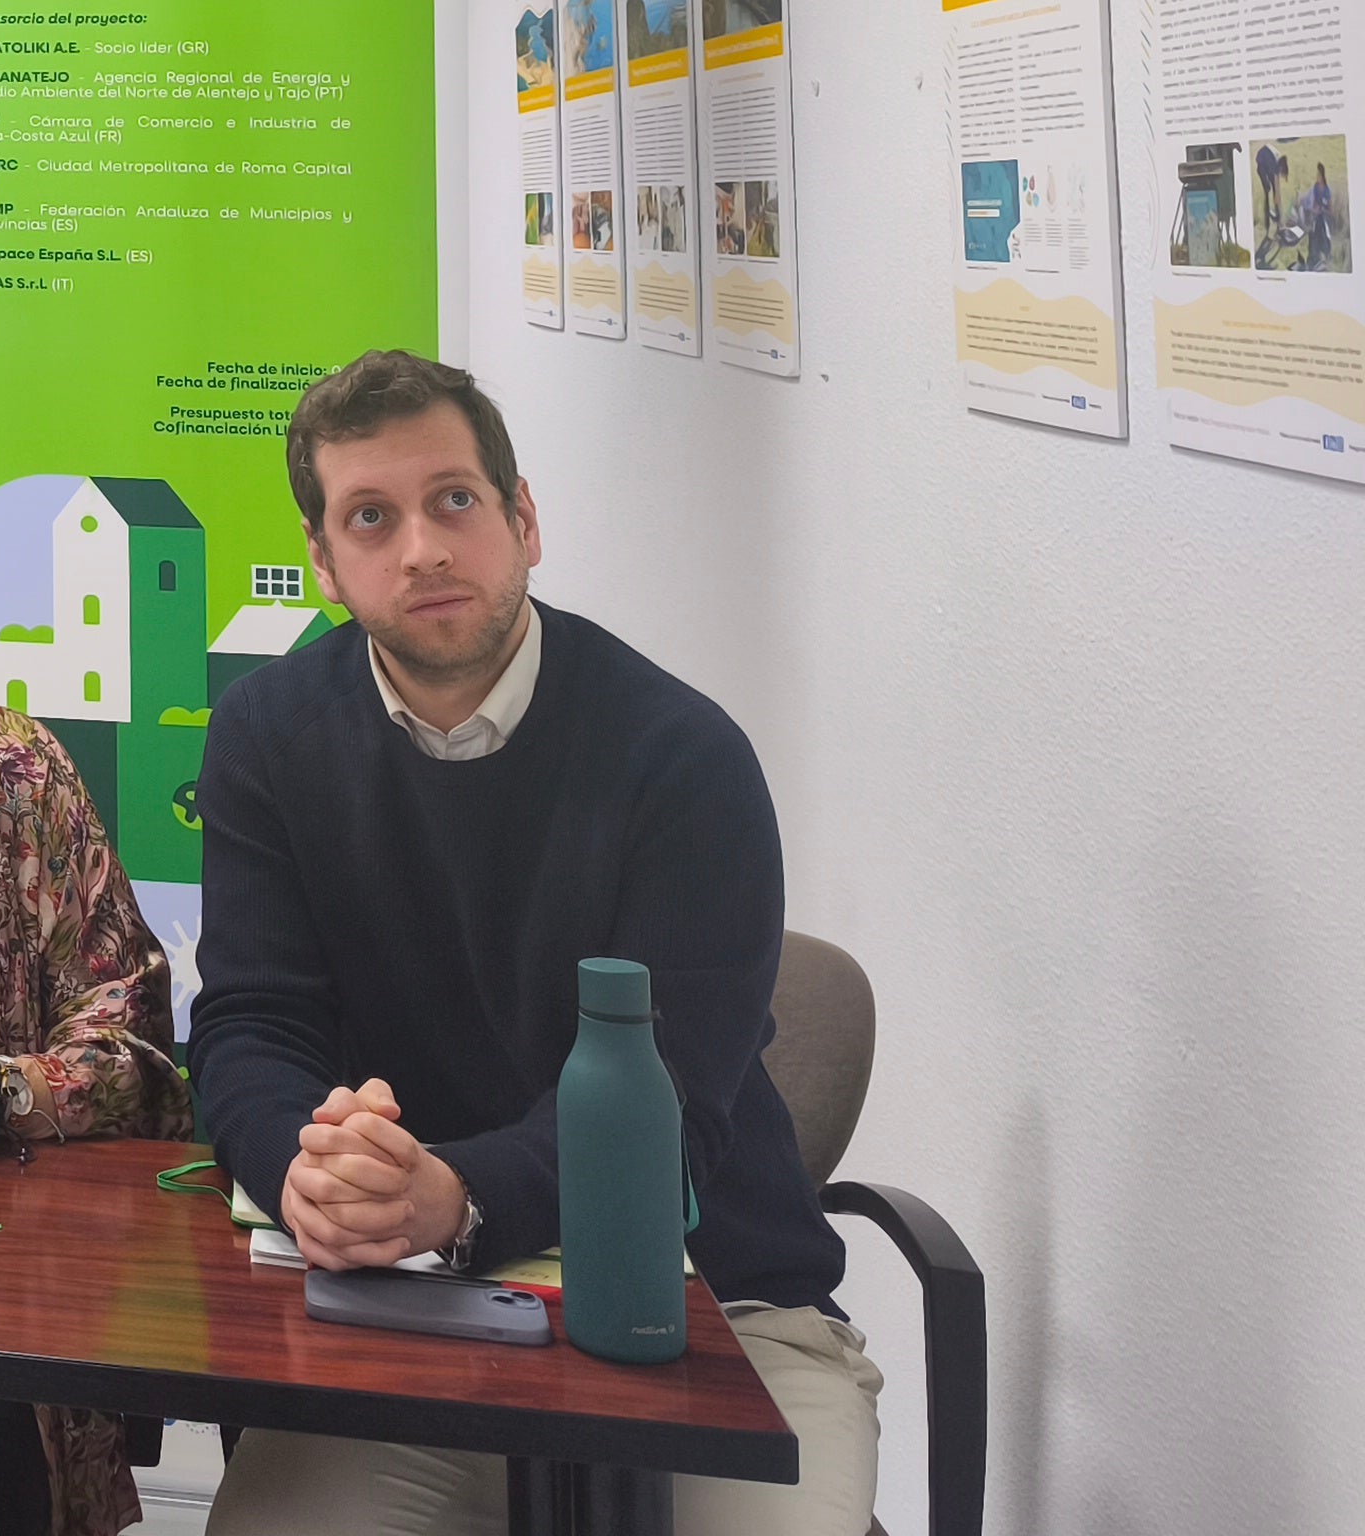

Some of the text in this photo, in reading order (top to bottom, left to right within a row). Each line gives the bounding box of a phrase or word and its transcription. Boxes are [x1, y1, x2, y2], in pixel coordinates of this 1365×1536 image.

[49, 13, 71, 23] del
[75, 14, 147, 26] proyecto:
[54, 43, 80, 53] A.E.
[95, 42, 135, 54] Socio
[178, 42, 210, 55] (GR)
[94, 72, 156, 87] Agencia
[167, 72, 233, 85] Regional
[243, 72, 262, 84] de
[341, 75, 349, 87] y
[21, 86, 93, 99] Ambiente
[98, 86, 121, 97] del
[126, 87, 167, 97] Norte
[172, 86, 191, 98] de
[196, 86, 259, 100] Alentejo
[264, 90, 273, 101] y
[278, 85, 310, 100] Tajo
[315, 86, 342, 100] (PT)
[30, 116, 91, 128] Cámara
[105, 117, 124, 130] de
[138, 116, 214, 129] Comercio
[227, 119, 235, 129] e
[250, 117, 316, 129] Industria
[331, 117, 350, 130] de
[59, 131, 90, 141] Azul
[95, 130, 121, 144] (FR)
[37, 160, 93, 172] Ciudad
[100, 161, 209, 174] Metropolitana
[215, 162, 234, 173] de
[241, 162, 286, 174] Roma
[293, 163, 352, 176] Capital
[41, 204, 125, 217] Federación
[136, 206, 210, 219] Andaluza
[220, 208, 238, 219] de
[251, 208, 333, 221] Municipios
[343, 212, 353, 223] y
[52, 219, 77, 232] (ES)
[39, 249, 93, 262] España
[125, 249, 152, 264] (ES)
[52, 279, 73, 292] (IT)
[208, 362, 254, 373] Fecha
[258, 363, 277, 374] de
[282, 364, 326, 376] inicio:
[157, 376, 203, 388] Fecha
[208, 377, 226, 388] de
[171, 407, 264, 421] Presupuesto
[154, 421, 271, 435] Cofinanciación
